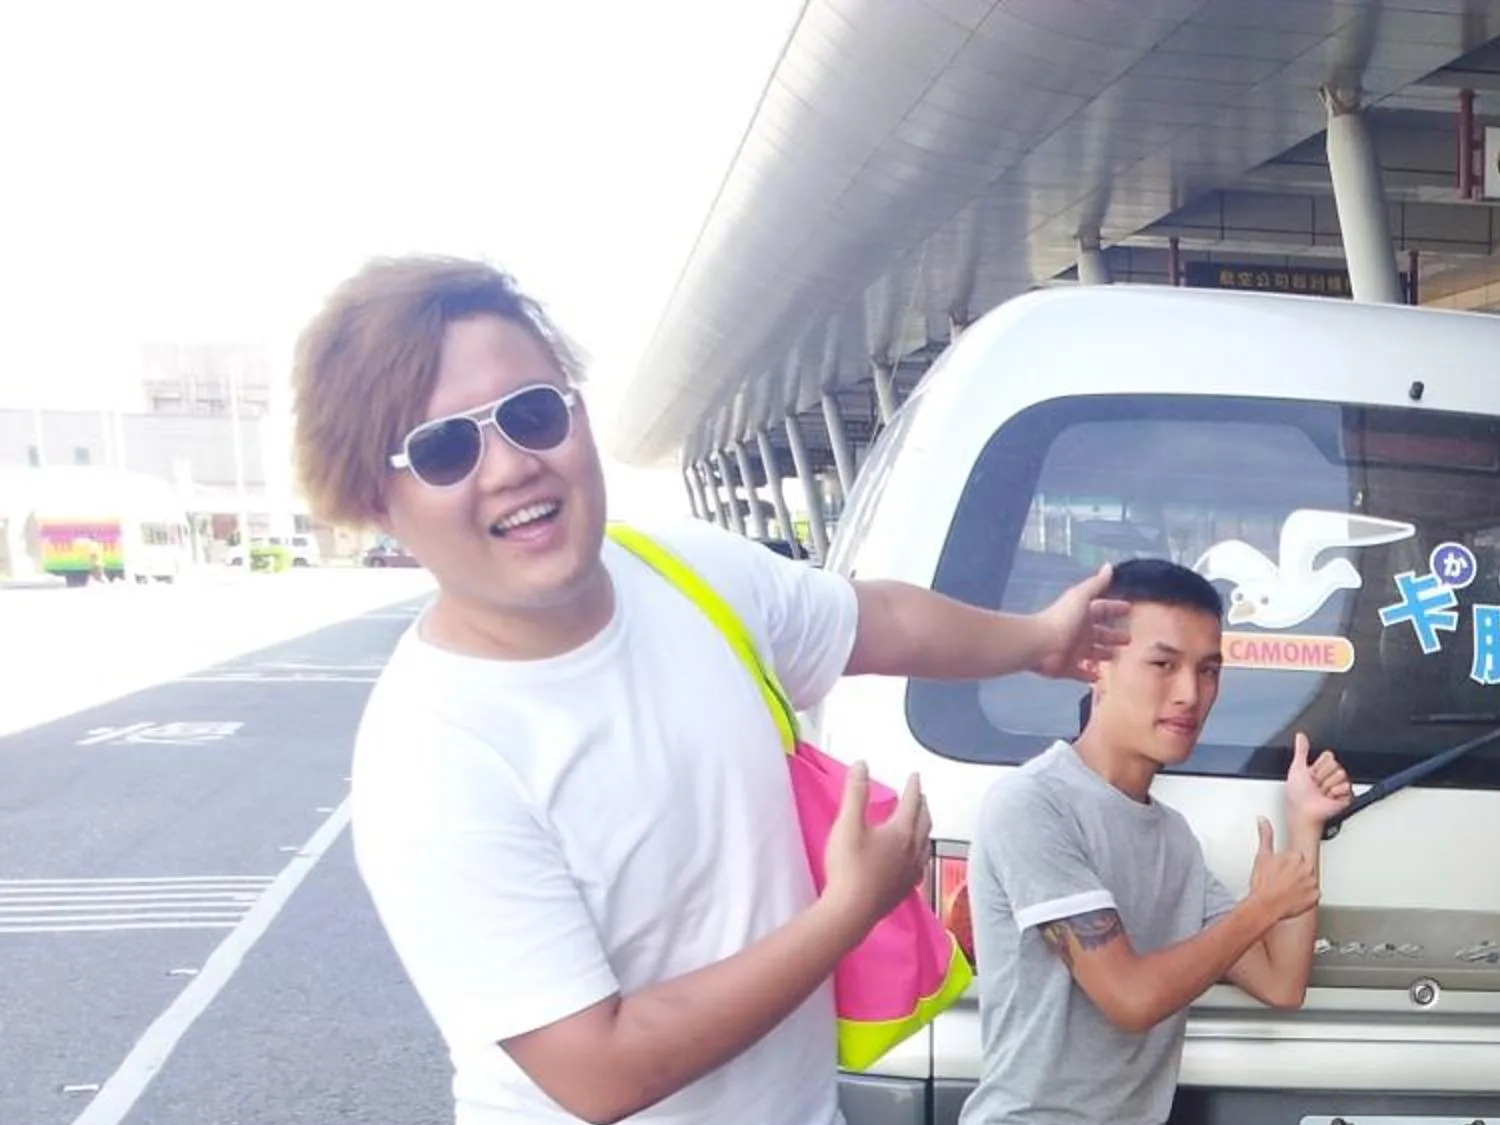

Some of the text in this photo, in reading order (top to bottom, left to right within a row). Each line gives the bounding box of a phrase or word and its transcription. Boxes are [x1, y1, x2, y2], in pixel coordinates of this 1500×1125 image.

[1219, 269, 1351, 292] 航空公司報到櫃
[1229, 641, 1336, 665] CAMOME
